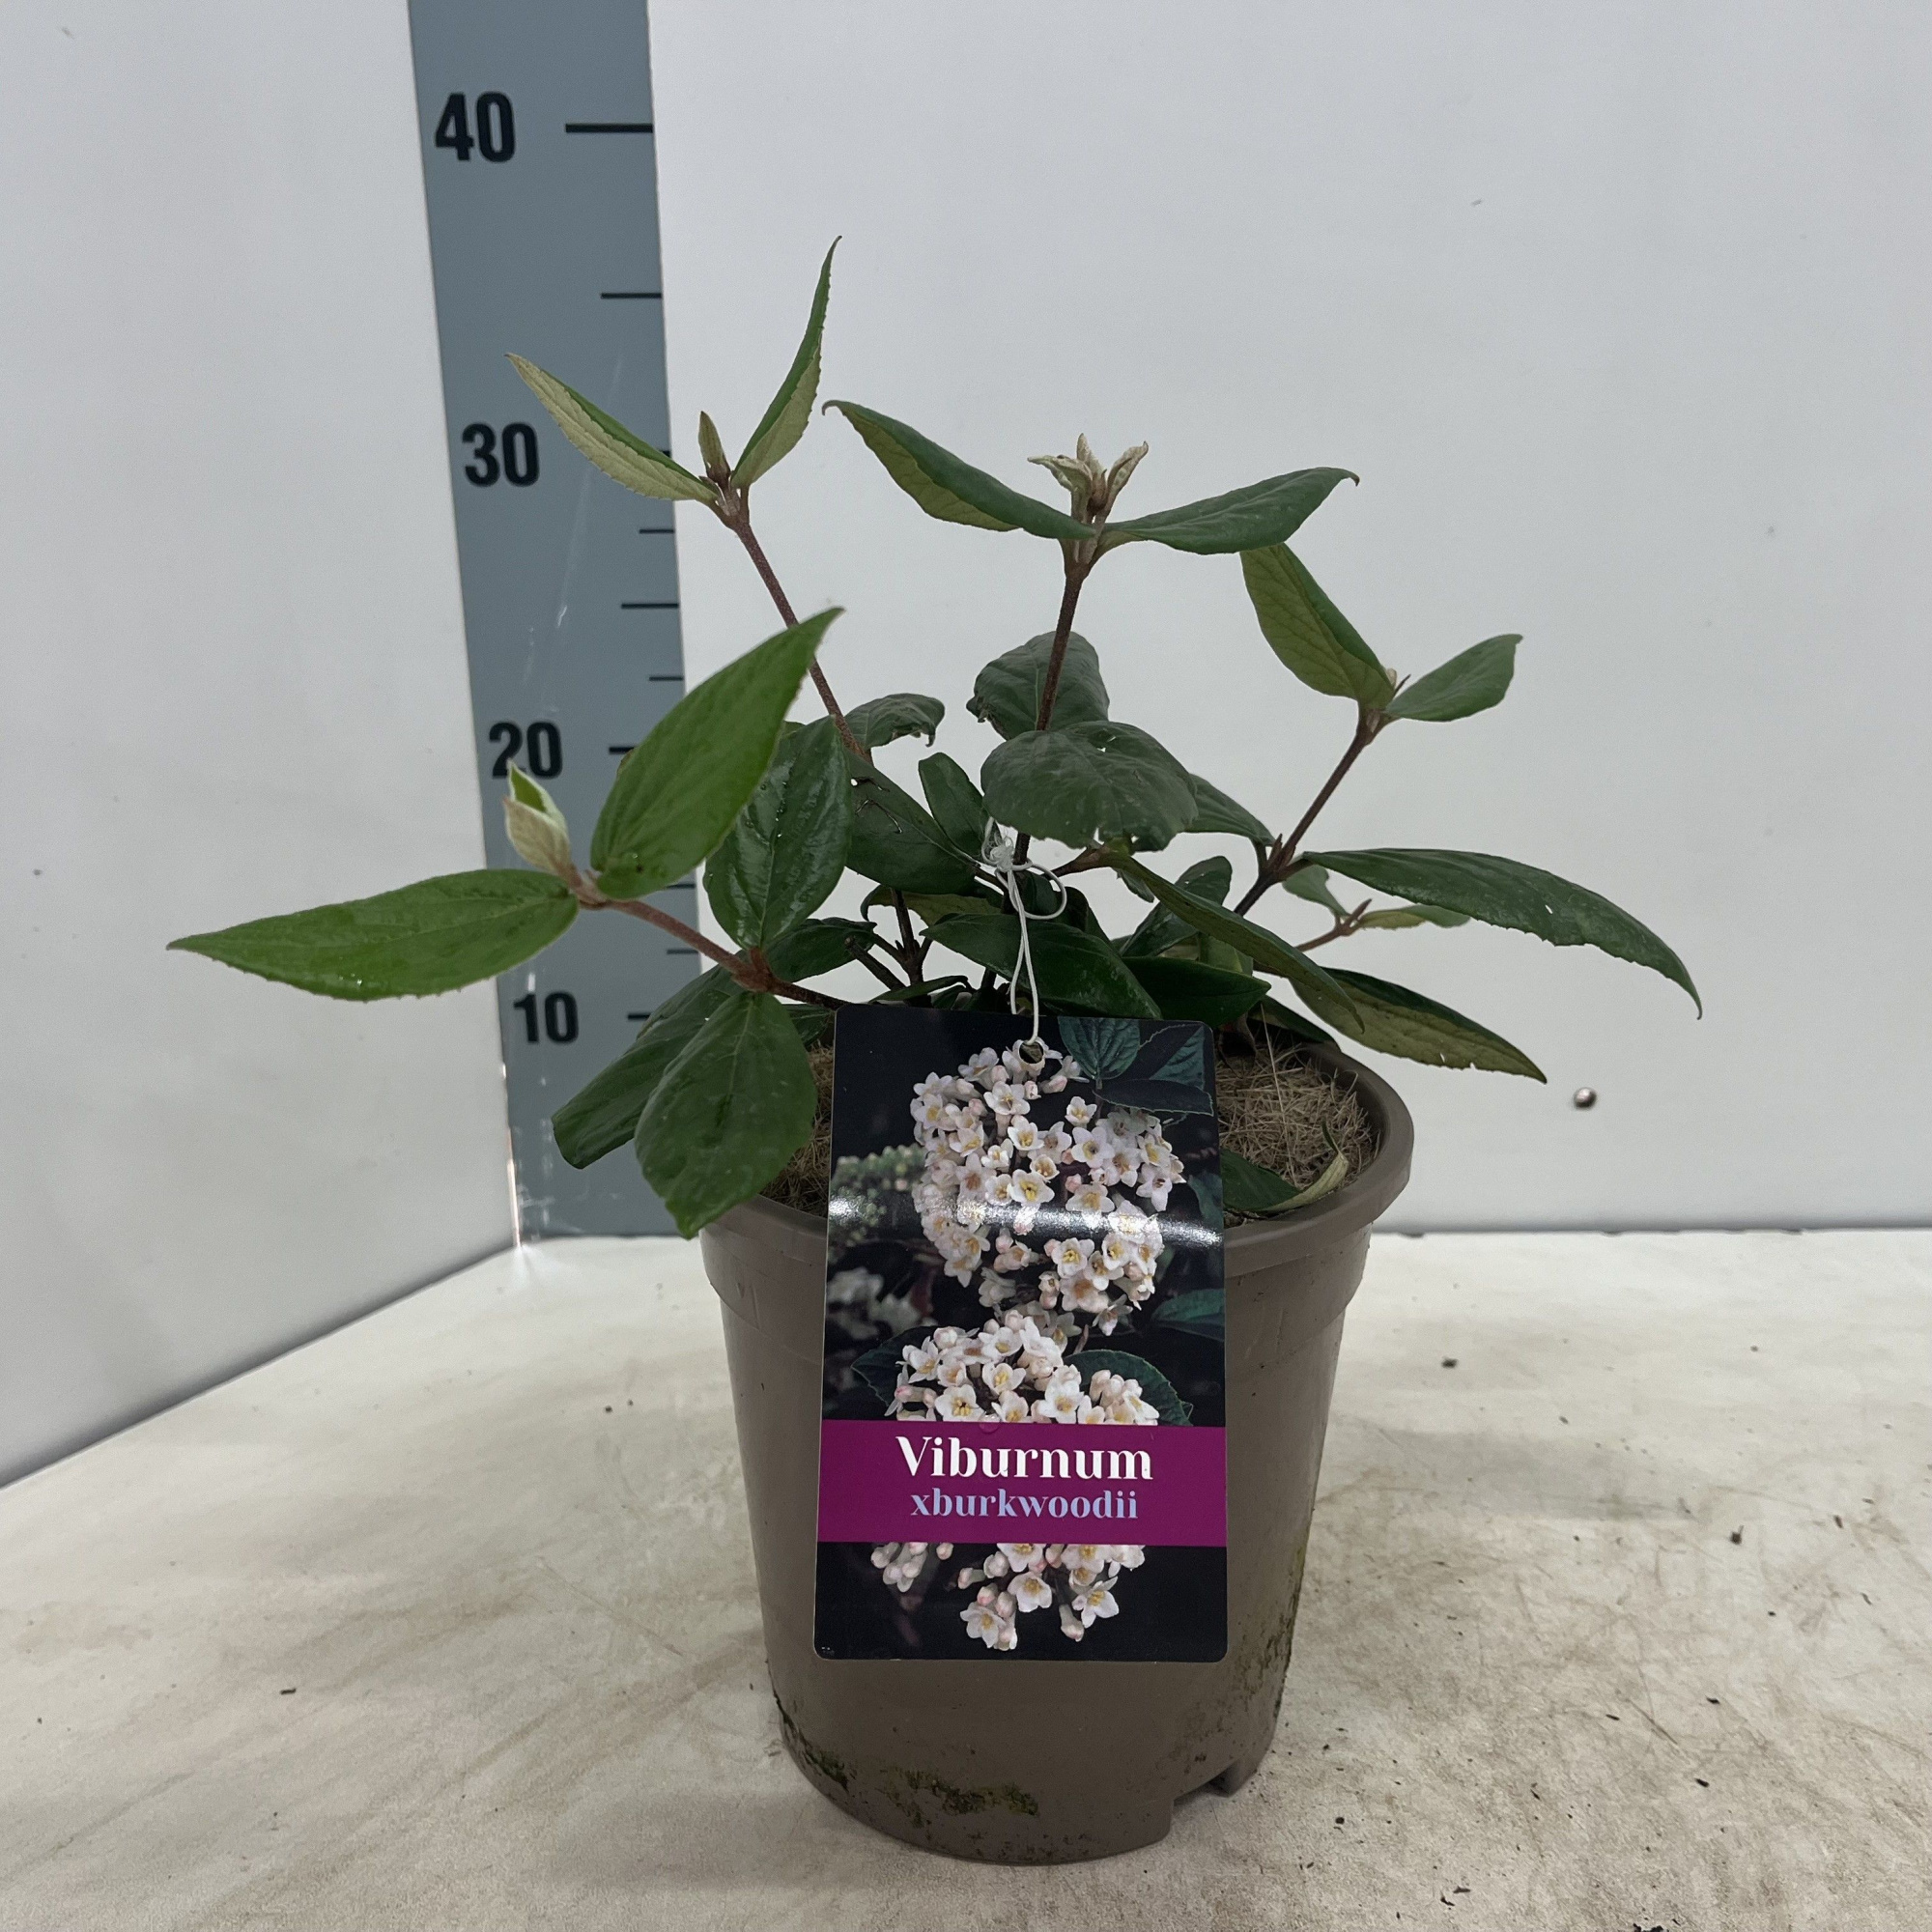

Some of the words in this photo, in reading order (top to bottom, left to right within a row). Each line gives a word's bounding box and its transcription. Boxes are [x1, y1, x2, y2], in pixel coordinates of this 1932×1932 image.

[435, 91, 516, 163] 40
[462, 422, 540, 488] 30
[488, 721, 563, 780] 20
[513, 990, 580, 1045] 10
[895, 1435, 1153, 1480] Viburnum
[910, 1487, 1138, 1520] xburkwoodii
